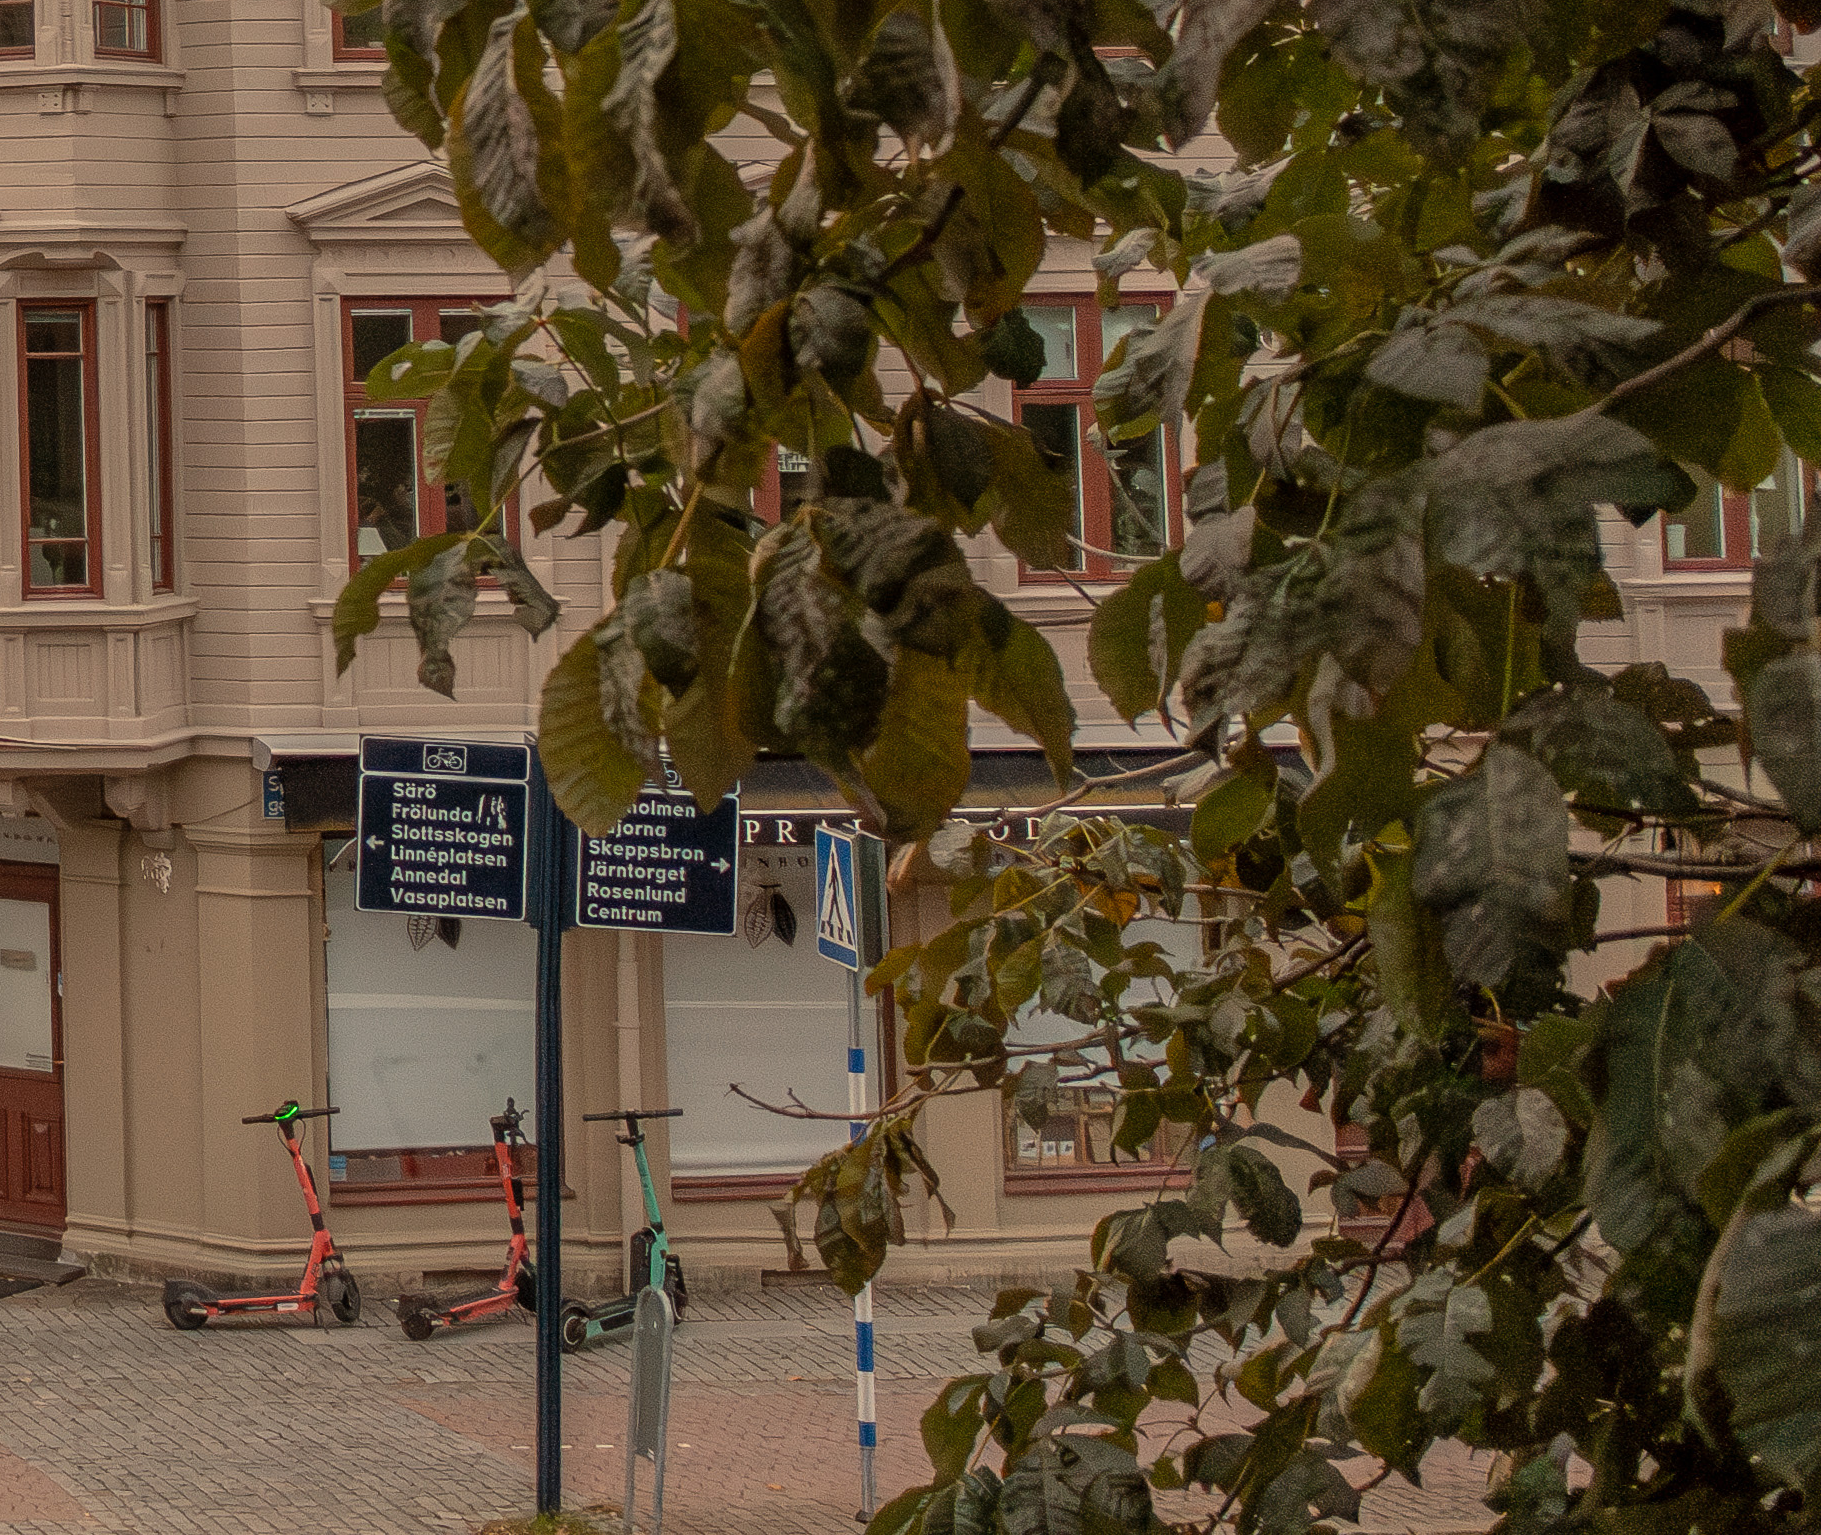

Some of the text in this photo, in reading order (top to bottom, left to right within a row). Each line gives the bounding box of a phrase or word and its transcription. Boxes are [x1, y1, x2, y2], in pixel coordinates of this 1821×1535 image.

[392, 782, 437, 799] Särö
[391, 802, 473, 823] Frölunda
[391, 824, 514, 849] Slottsskogen
[390, 845, 508, 868] Linnéplatsen
[588, 840, 705, 862] Skeppsbron
[390, 866, 468, 886] Annedal
[587, 861, 687, 883] Järntorget
[390, 888, 508, 911] Vasaplatsen
[587, 881, 687, 903] Rosenlund
[587, 903, 663, 923] Centrum
